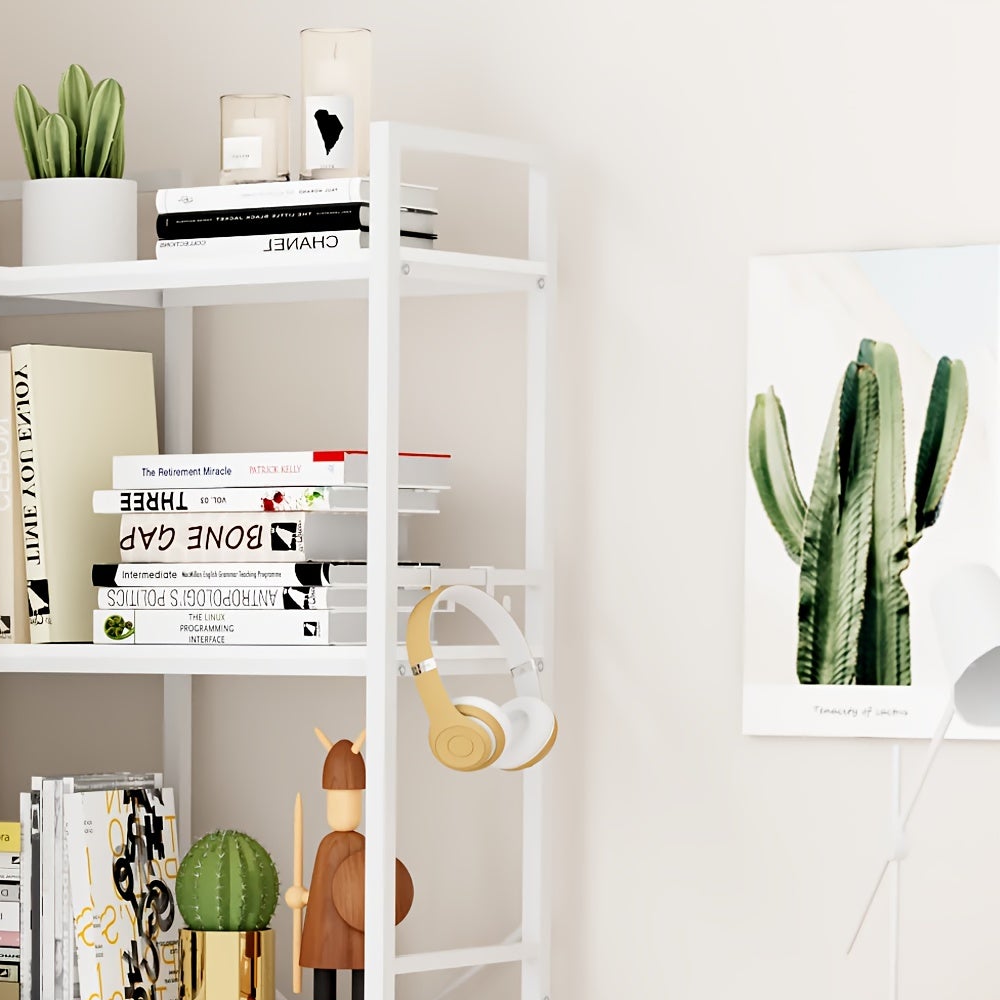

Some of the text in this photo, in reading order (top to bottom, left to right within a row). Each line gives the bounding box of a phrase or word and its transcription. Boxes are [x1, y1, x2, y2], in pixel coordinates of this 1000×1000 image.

[142, 464, 302, 477] The Retirement Miracle PATRICK KELLY
[120, 492, 188, 512] THREE
[119, 524, 264, 551] BONE GAP
[122, 570, 178, 580] Intermediate
[107, 588, 279, 608] ANTROPOLOGI'S POLITICS
[188, 613, 226, 622] THE LINUX
[179, 624, 235, 634] PROGRAMMING
[188, 635, 226, 645] INTERFACE
